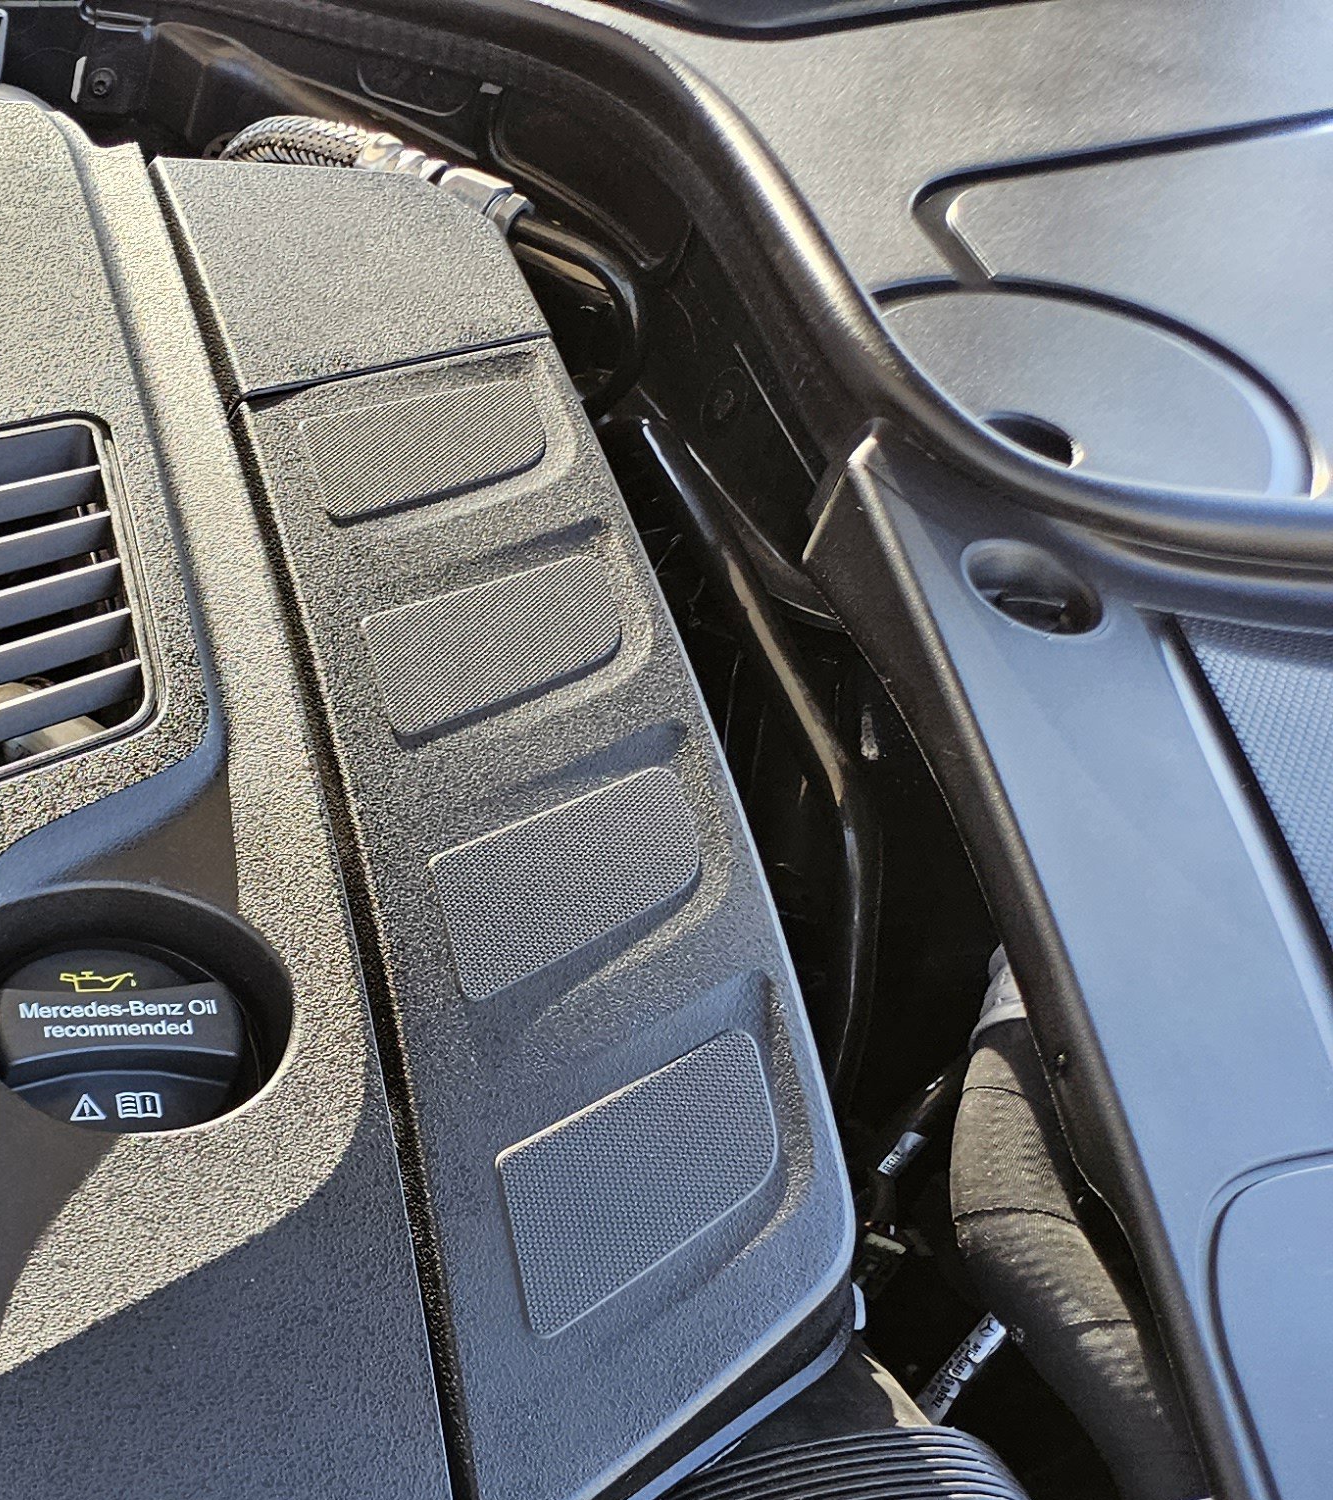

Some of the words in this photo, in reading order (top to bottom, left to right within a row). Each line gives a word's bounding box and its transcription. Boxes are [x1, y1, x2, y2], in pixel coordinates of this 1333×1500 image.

[18, 1000, 184, 1019] Mercedes-Benz
[188, 998, 218, 1016] Oil
[43, 1019, 194, 1038] recommended
